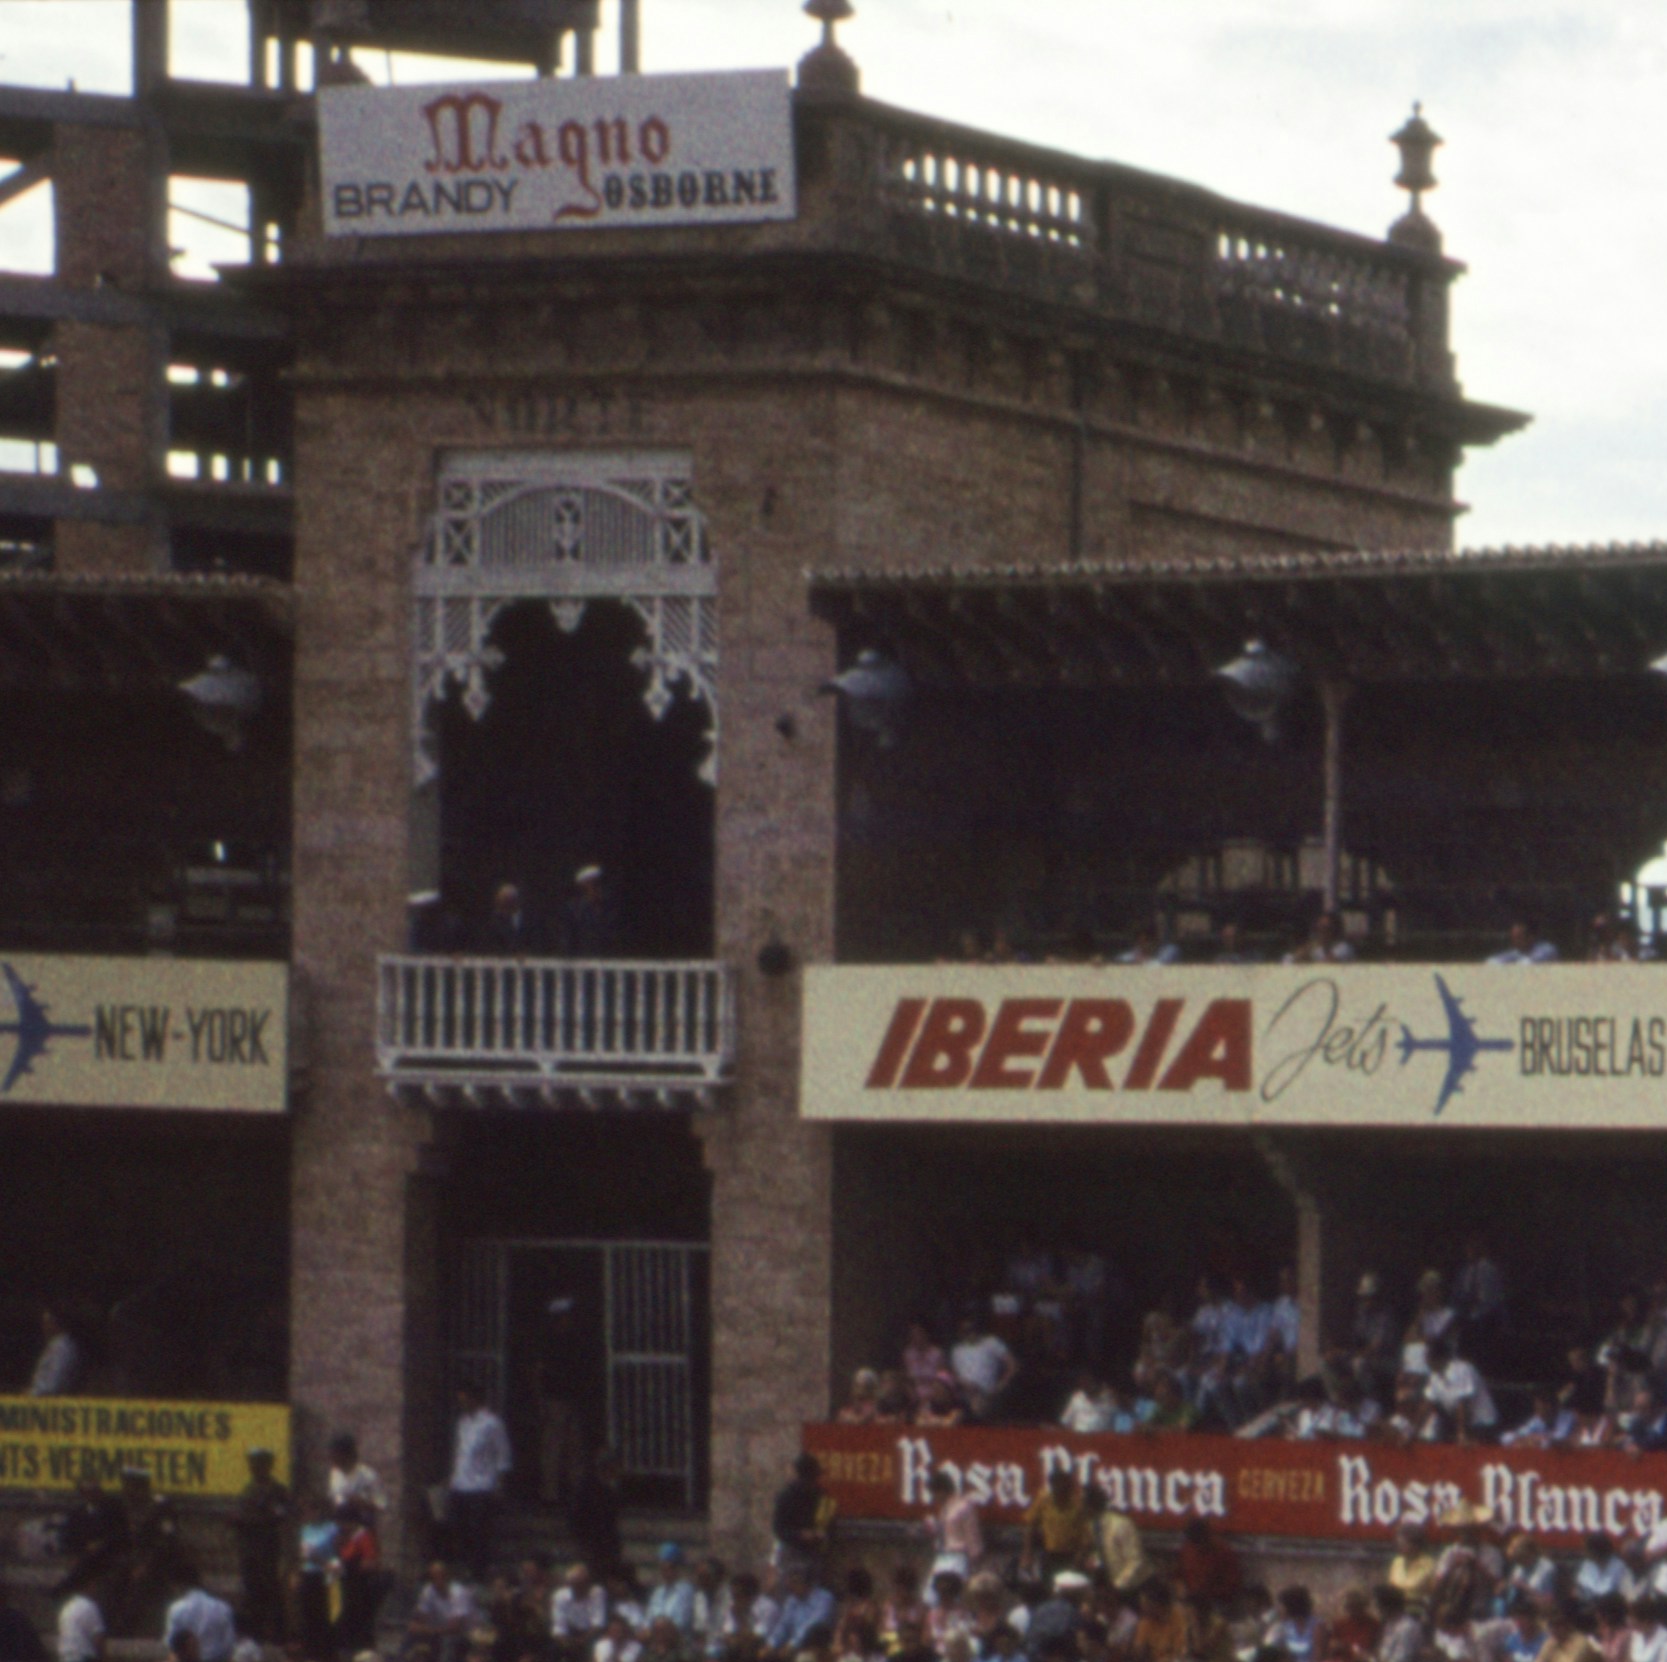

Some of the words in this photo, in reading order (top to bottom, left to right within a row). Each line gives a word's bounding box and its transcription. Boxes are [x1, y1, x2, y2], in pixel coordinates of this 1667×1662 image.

[424, 92, 671, 223] Magno
[333, 178, 519, 219] BRANDY
[603, 168, 778, 209] OSBORNE
[95, 1004, 271, 1066] NEW-YORK
[864, 997, 1253, 1090] IBERIA
[1261, 977, 1396, 1101] Jets
[1521, 1017, 1666, 1076] BRUSELAS
[814, 1452, 893, 1484] ERVEZA
[1238, 1466, 1325, 1501] CERVEZA
[1338, 1454, 1464, 1527] Rosa
[1481, 1463, 1666, 1535] Blanca
